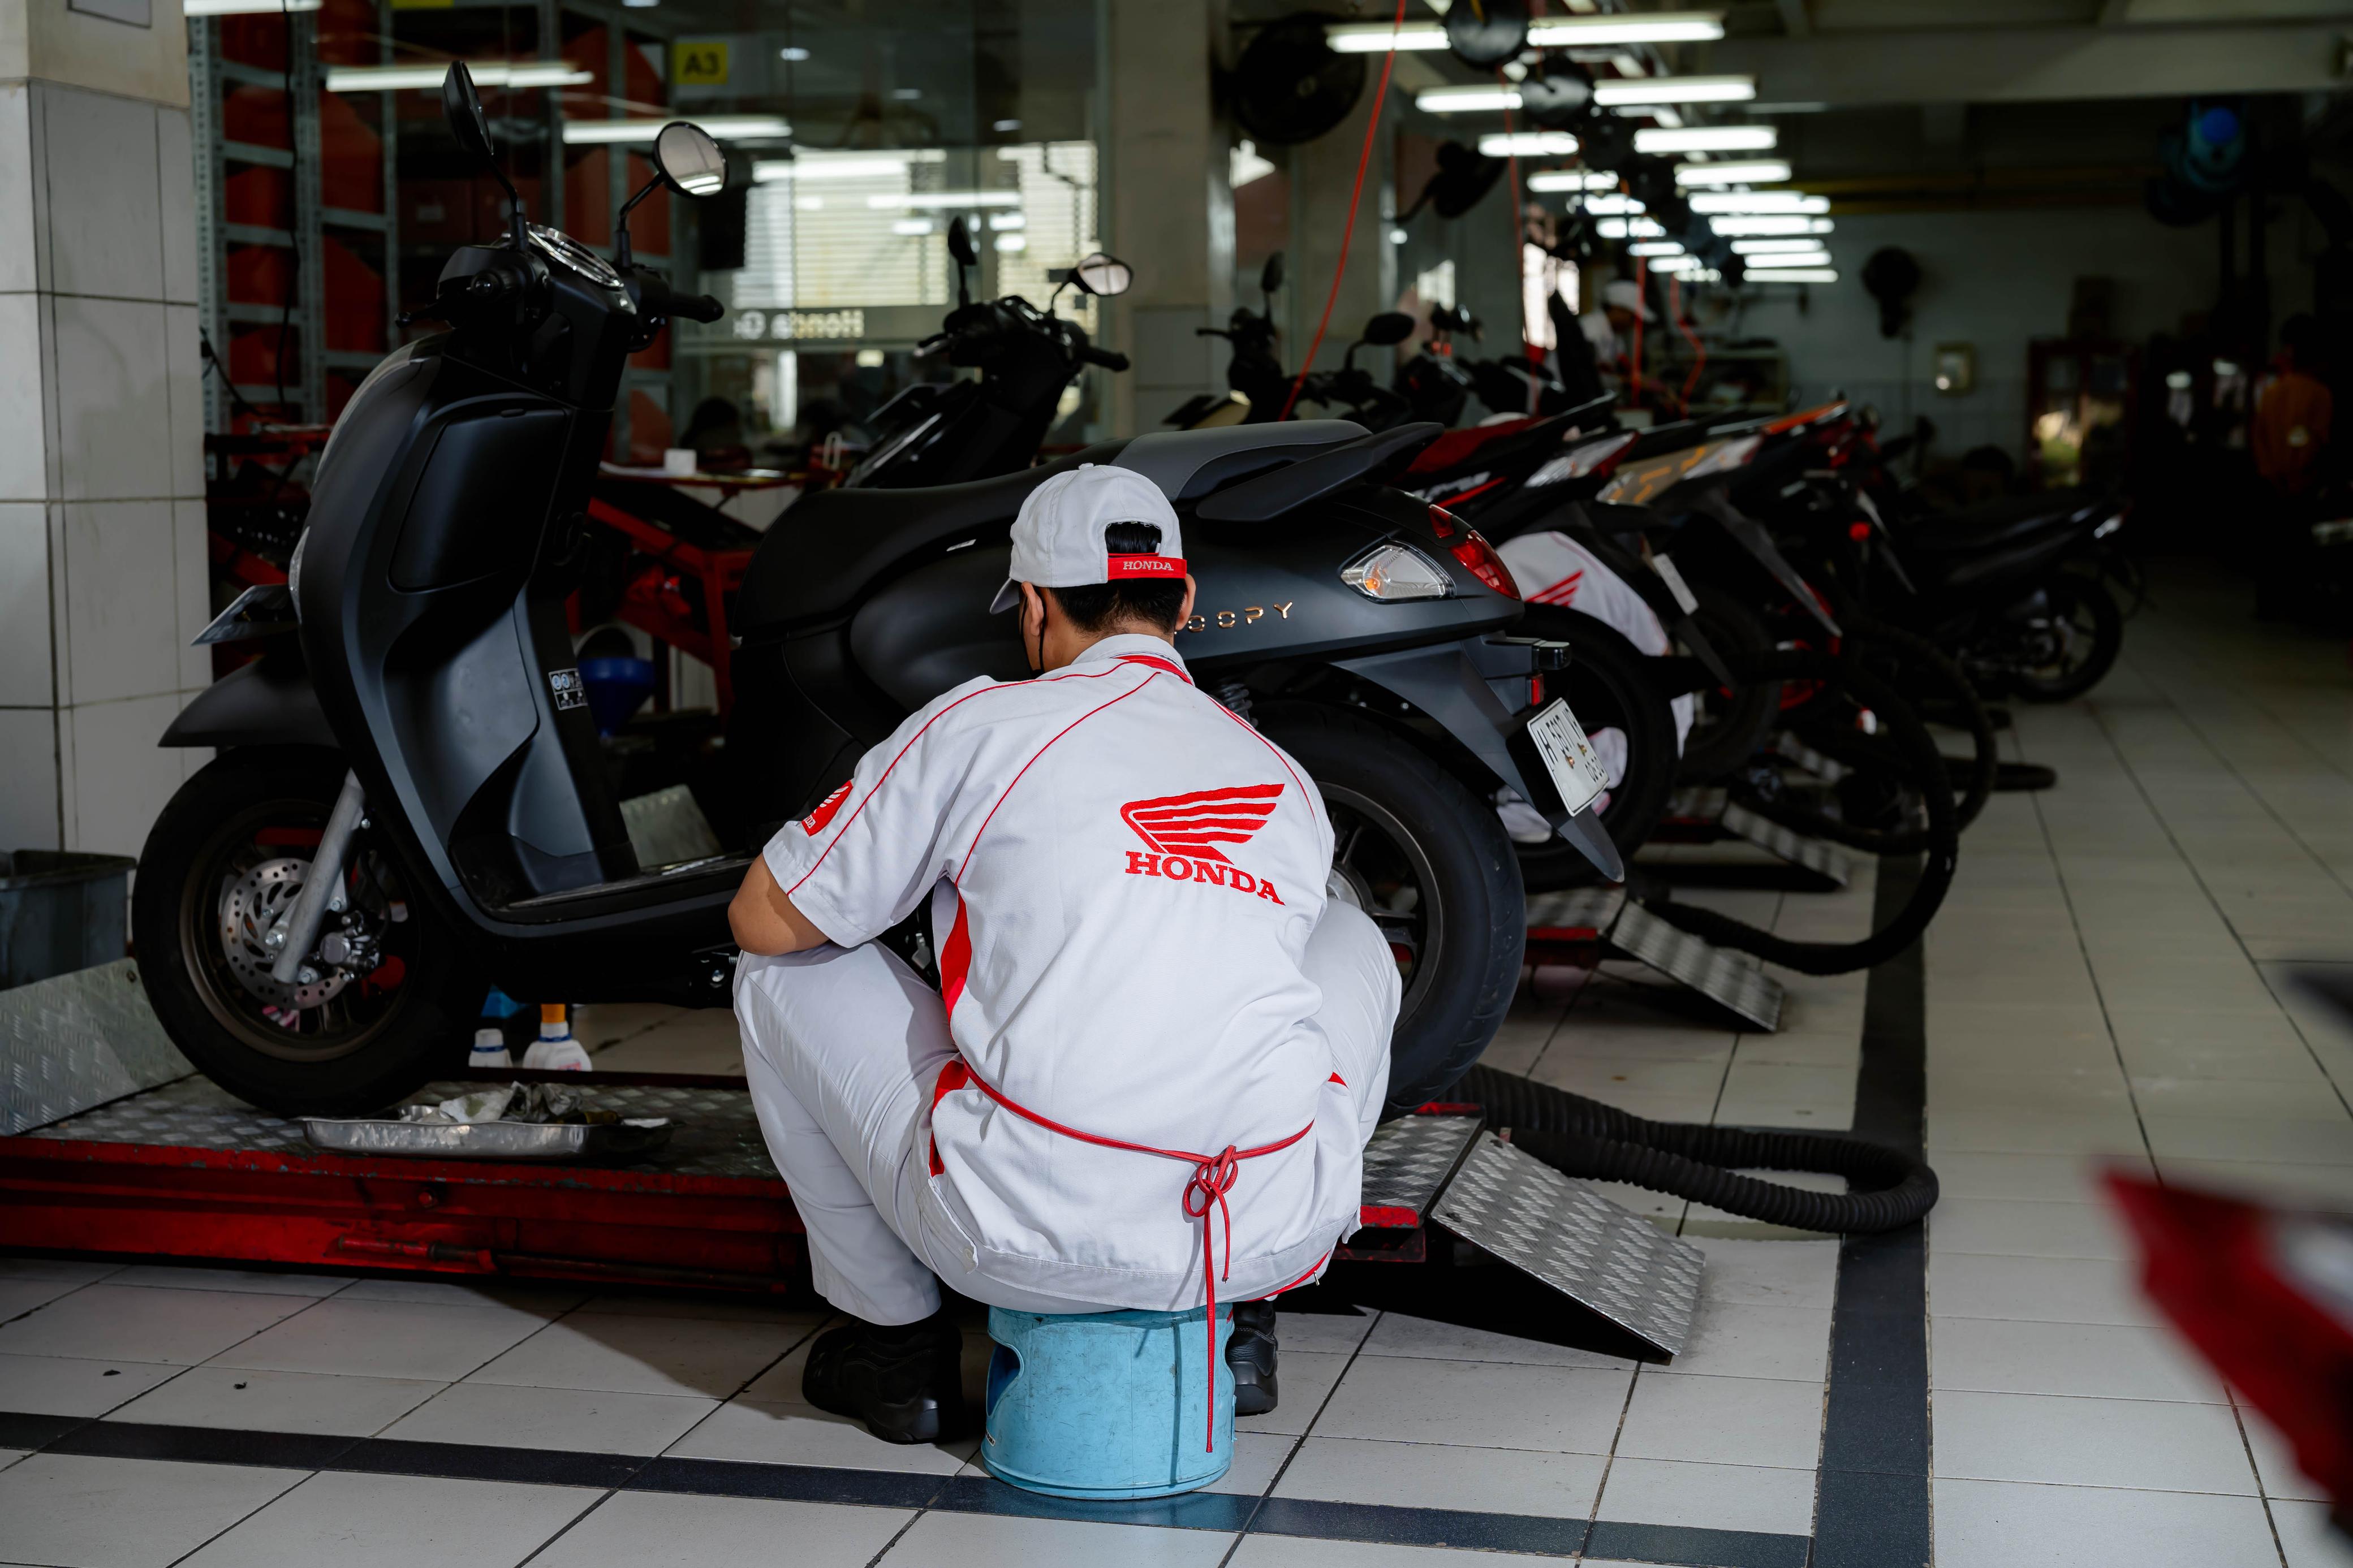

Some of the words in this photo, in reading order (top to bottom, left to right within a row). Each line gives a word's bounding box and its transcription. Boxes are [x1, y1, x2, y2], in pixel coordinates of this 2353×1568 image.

[683, 51, 719, 76] A3
[1123, 560, 1174, 571] HONDA
[1174, 602, 1293, 634] OOPY
[1536, 728, 1558, 764] H
[1545, 715, 1575, 757] 5617
[1124, 850, 1286, 906] HONDA
